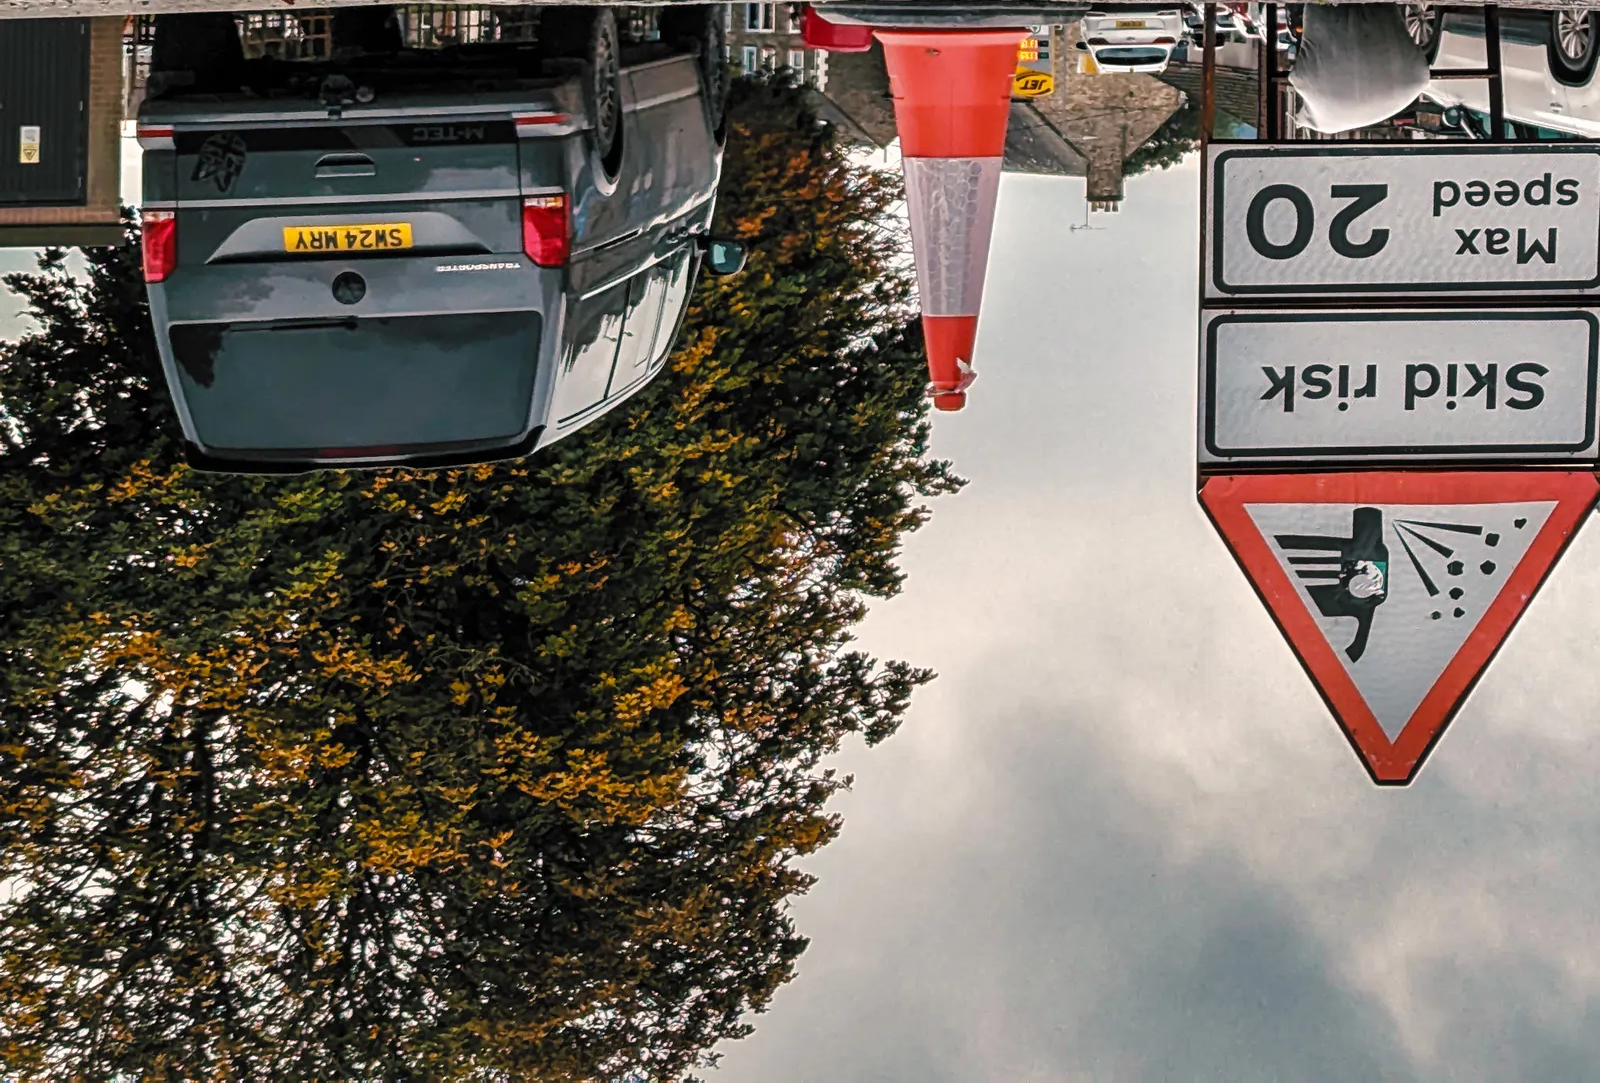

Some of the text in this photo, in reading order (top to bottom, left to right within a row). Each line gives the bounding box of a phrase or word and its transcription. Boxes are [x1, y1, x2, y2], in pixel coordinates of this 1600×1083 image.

[1019, 79, 1047, 91] JET
[412, 126, 484, 141] M-TEC
[1432, 173, 1579, 216] speed
[1245, 183, 1390, 260] 20
[295, 228, 403, 250] SW24 MRY
[1456, 224, 1557, 264] Max
[436, 262, 521, 273] TRANSPORTER
[1260, 362, 1548, 411] Skid risk
